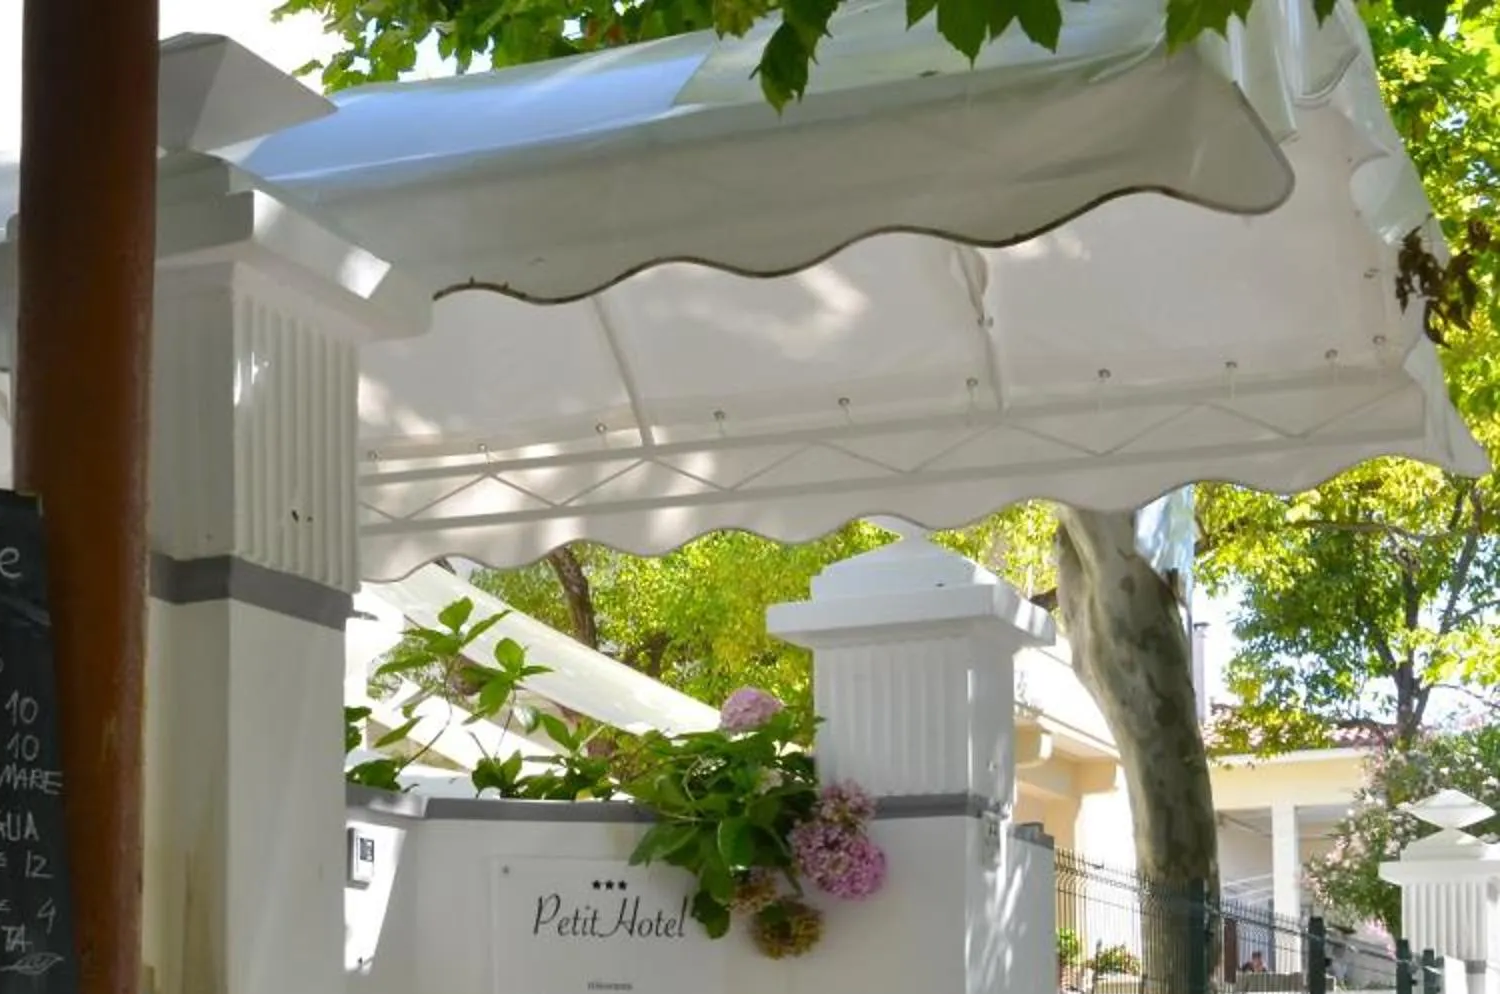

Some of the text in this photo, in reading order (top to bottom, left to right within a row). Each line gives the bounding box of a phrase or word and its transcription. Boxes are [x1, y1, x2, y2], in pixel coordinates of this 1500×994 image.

[4, 689, 39, 725] 10
[6, 733, 40, 761] 10
[24, 851, 55, 879] 12
[37, 897, 57, 934] 4
[533, 893, 690, 938] Petit Hotel
